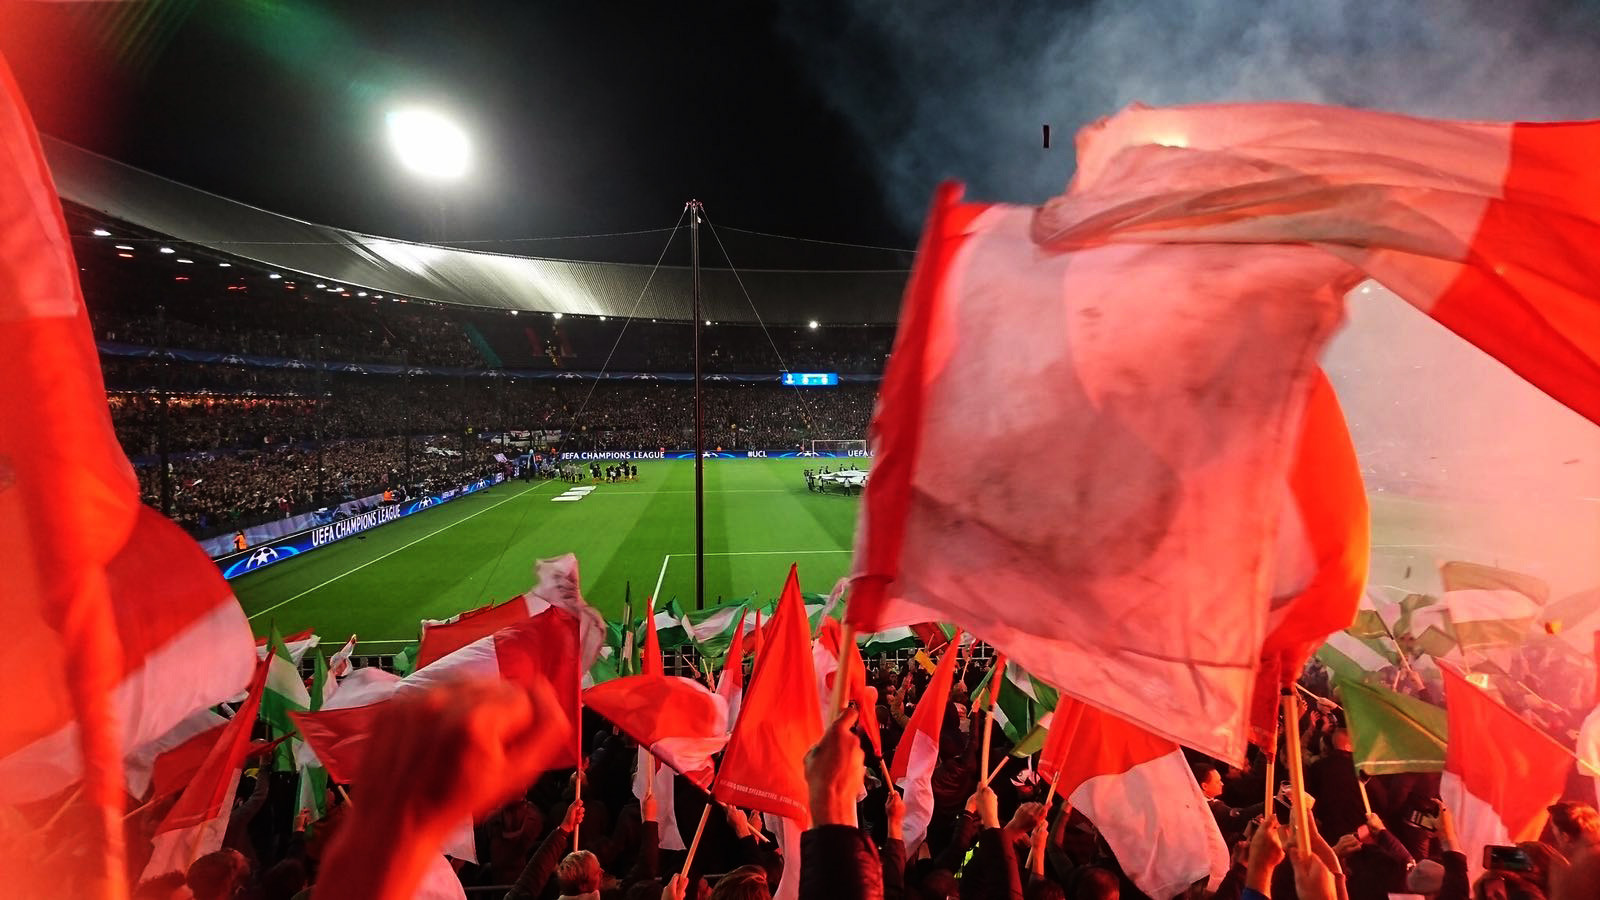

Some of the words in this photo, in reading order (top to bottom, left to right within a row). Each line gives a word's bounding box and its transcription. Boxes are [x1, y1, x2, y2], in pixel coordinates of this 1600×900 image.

[581, 452, 631, 460] CHAMPIONS
[633, 451, 665, 459] LEAGUE
[847, 449, 868, 457] UEFA
[312, 525, 335, 547] UEFA
[335, 512, 377, 539] CHAMPIONS
[378, 504, 401, 524] LEAGUE
